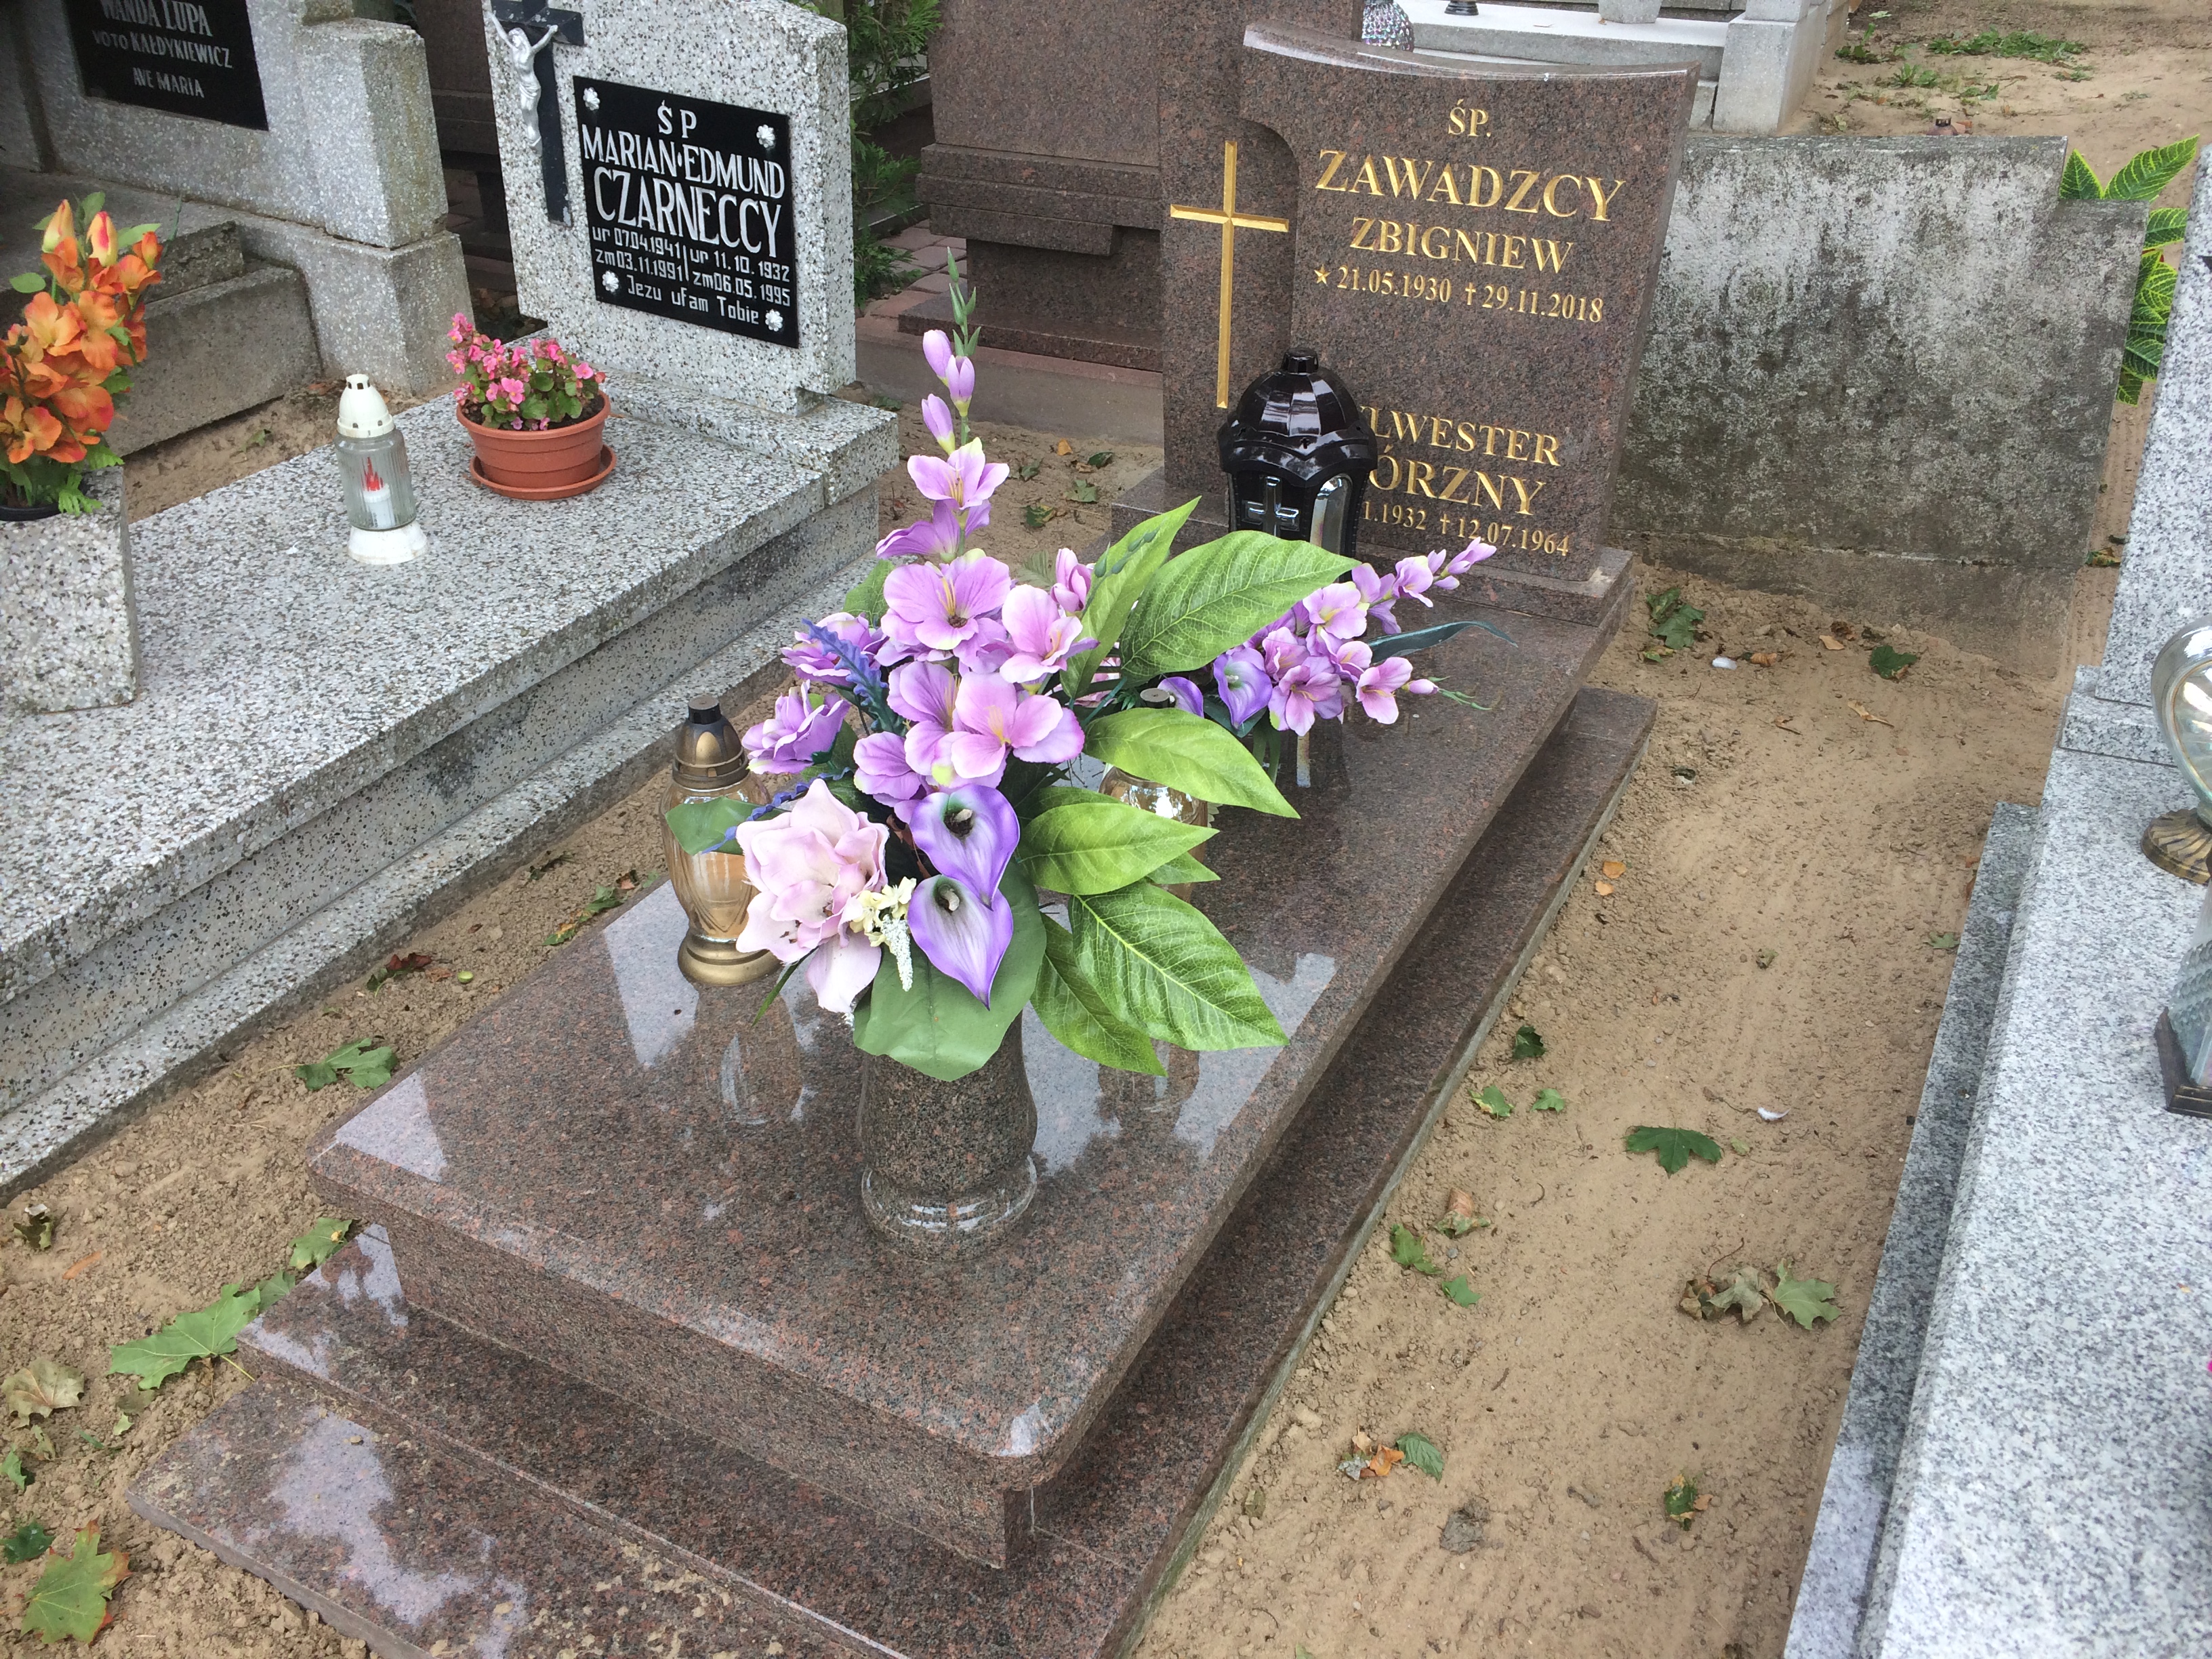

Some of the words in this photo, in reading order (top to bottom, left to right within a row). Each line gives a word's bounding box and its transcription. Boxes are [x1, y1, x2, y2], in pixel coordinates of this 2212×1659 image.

[161, 0, 213, 37] LUPA
[132, 67, 154, 89] AVE
[156, 70, 205, 98] MARIA
[1448, 99, 1492, 138] ŚP.
[593, 166, 781, 258] CZARNECCY
[1315, 148, 1626, 222] ZAWADZCY
[592, 226, 611, 242] ur
[690, 248, 710, 264] ur
[1349, 216, 1574, 274] ZBIGNIEW
[626, 274, 662, 301] Jezu
[671, 287, 709, 312] ufam
[716, 295, 760, 325] Tobie
[1337, 264, 1452, 304] 21.05.1930
[1481, 284, 1605, 323] 29.11.2018
[1359, 405, 1561, 466] LWESTER
[1368, 444, 1547, 516] ÓRZNY
[1362, 501, 1427, 531] 1.1932
[1458, 516, 1570, 556] 12.07.1964
